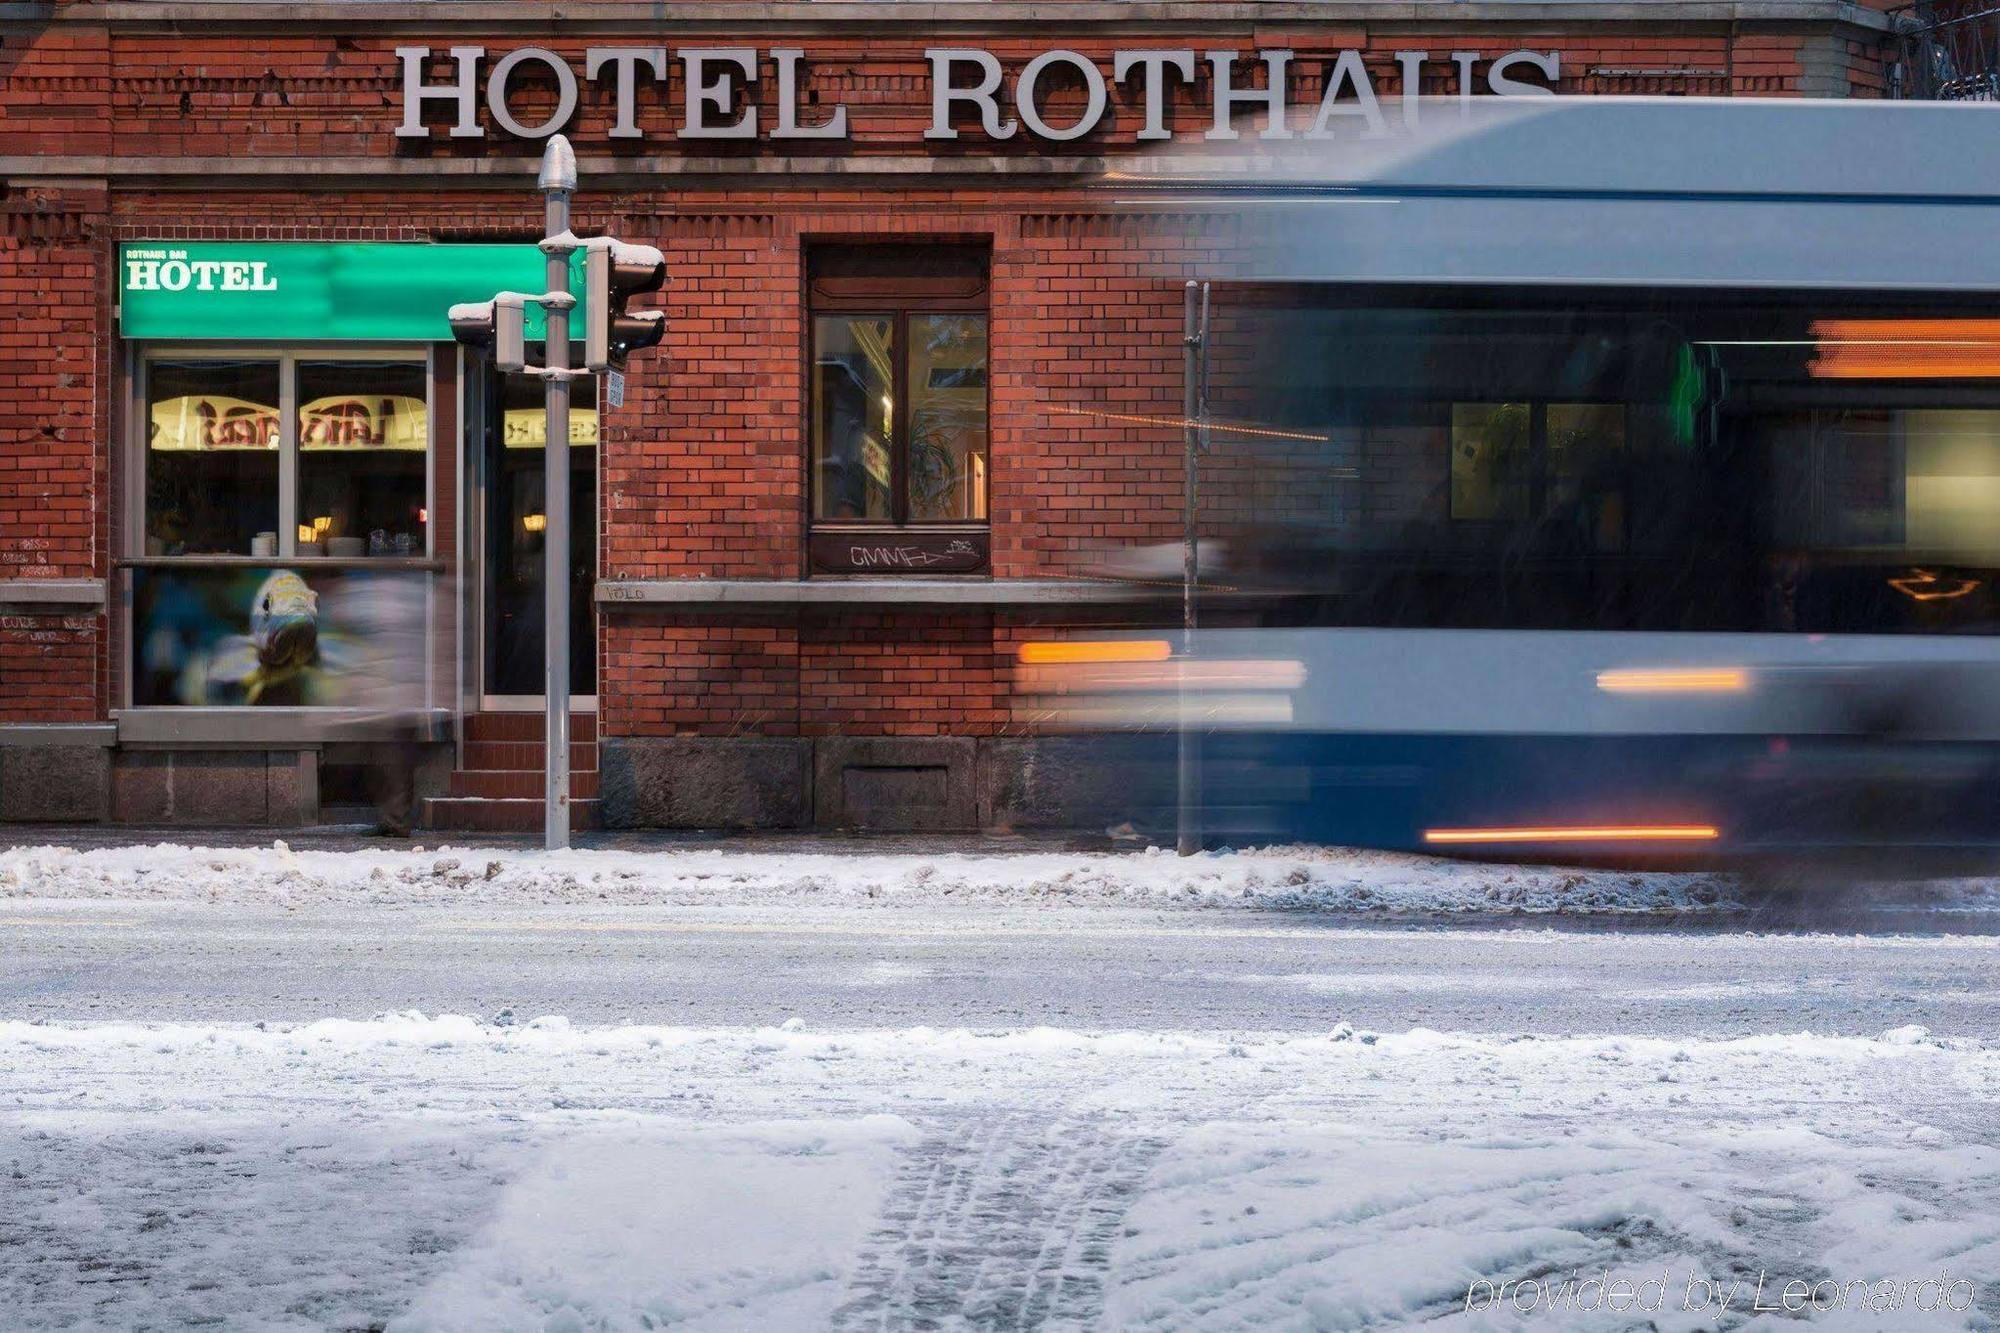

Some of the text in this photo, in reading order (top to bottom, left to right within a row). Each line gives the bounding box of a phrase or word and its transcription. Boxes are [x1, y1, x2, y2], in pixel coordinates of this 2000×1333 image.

[394, 46, 847, 140] HOTEL
[126, 250, 166, 259] ROTHAUS
[126, 261, 277, 291] HOTEL
